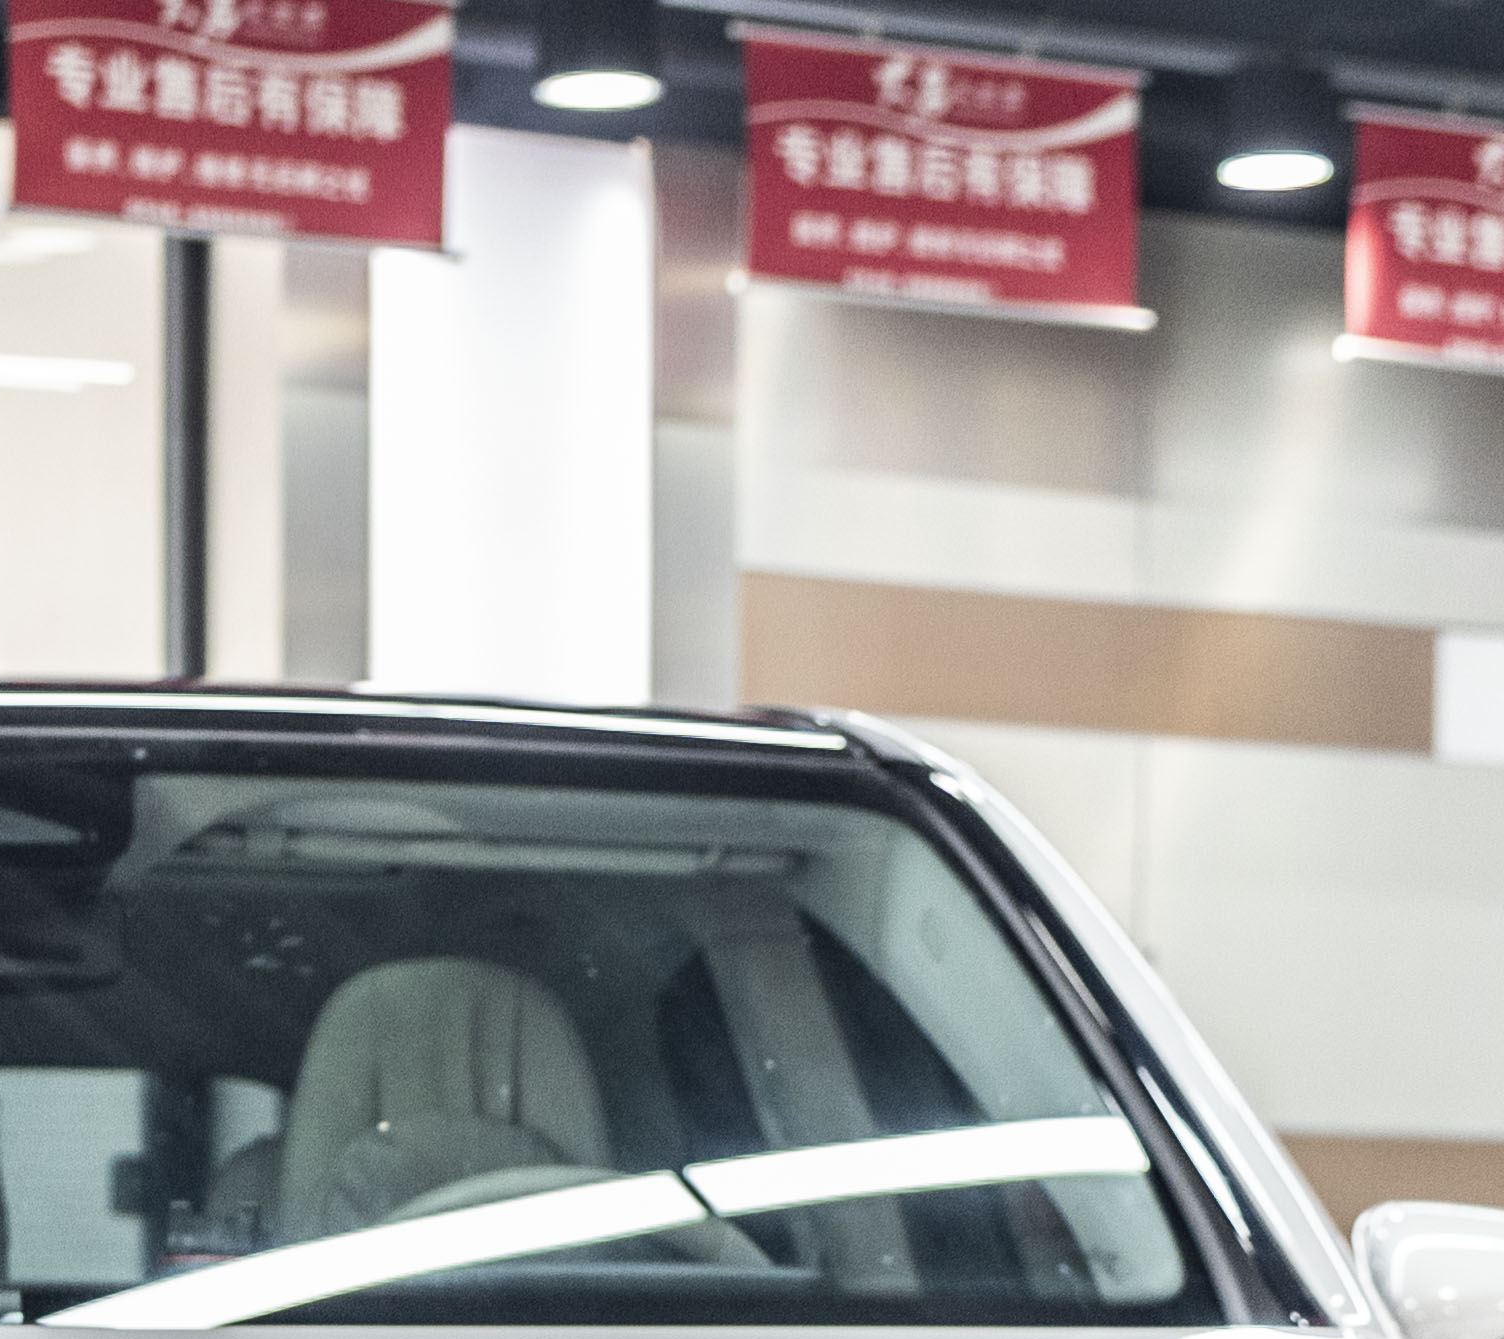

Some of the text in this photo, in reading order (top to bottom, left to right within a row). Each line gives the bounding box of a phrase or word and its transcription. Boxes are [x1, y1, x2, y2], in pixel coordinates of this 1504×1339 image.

[45, 42, 405, 142] 专业售后有保障
